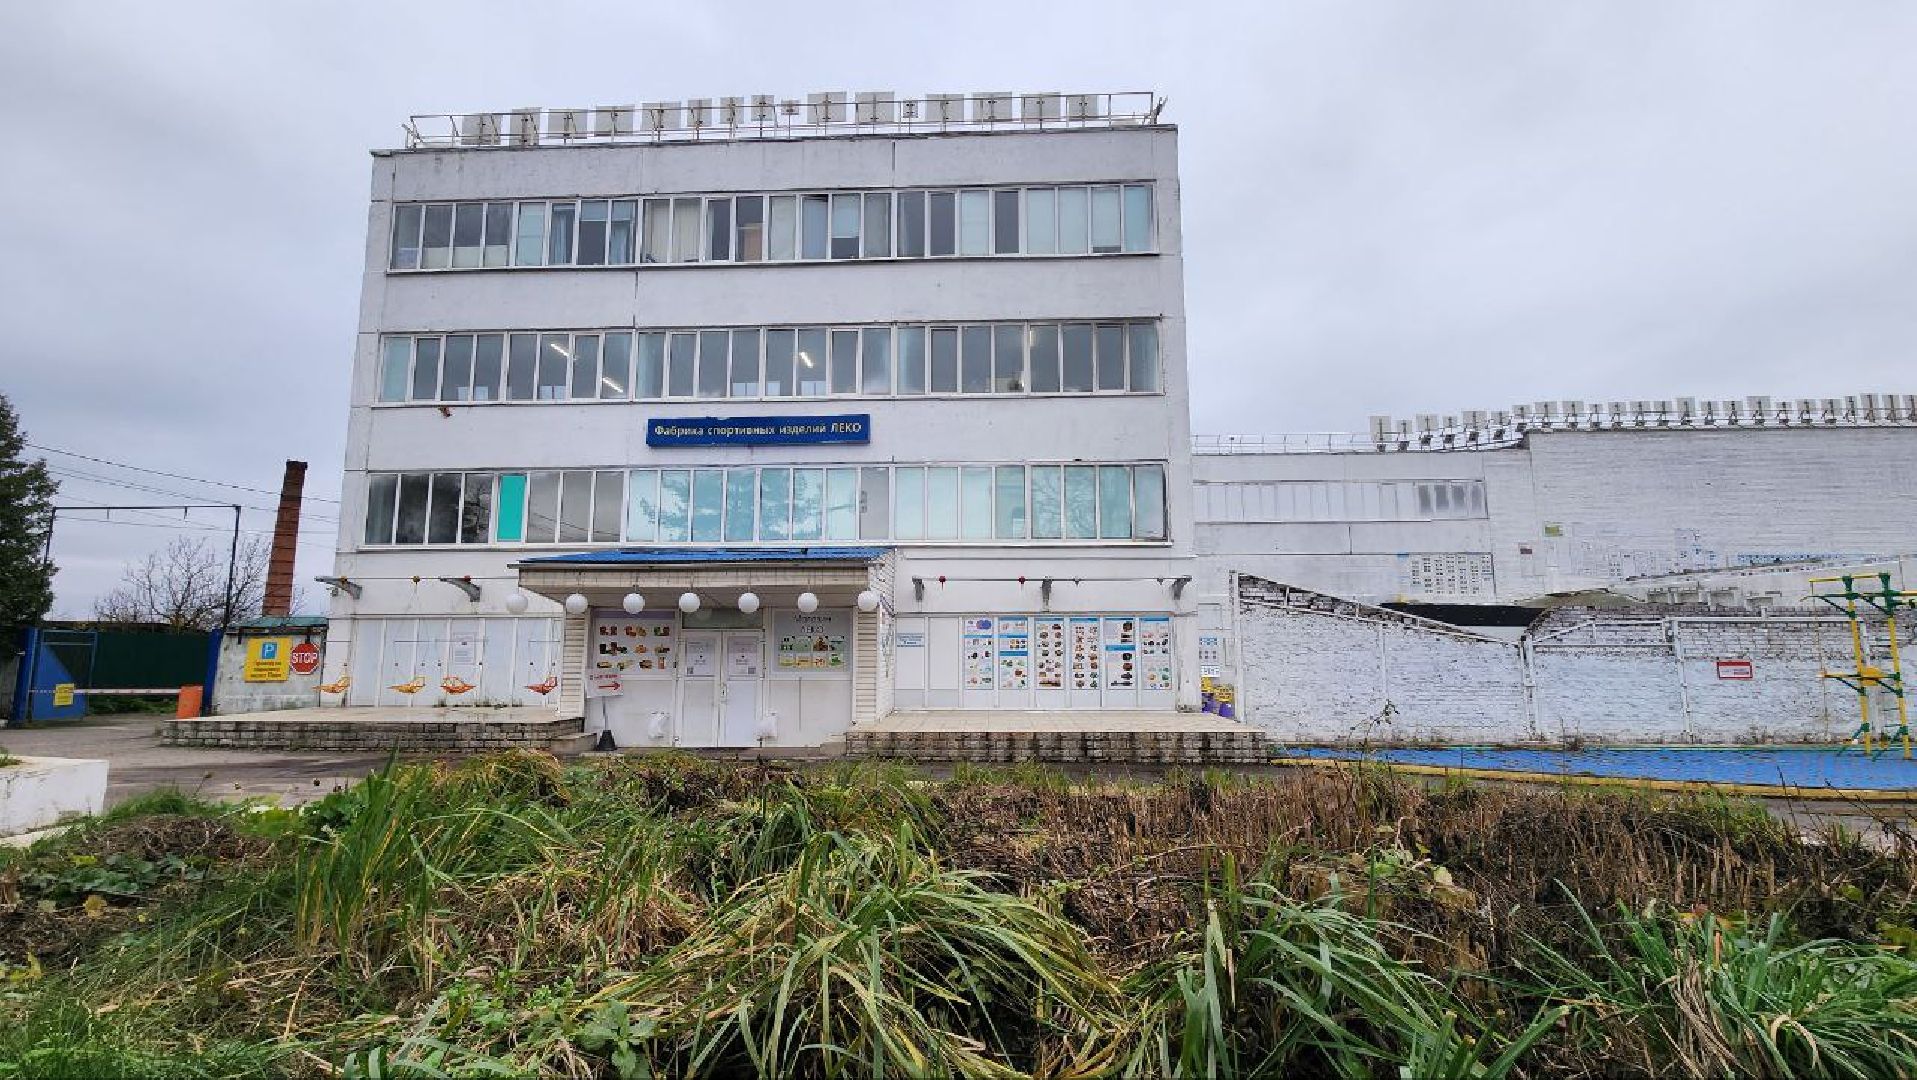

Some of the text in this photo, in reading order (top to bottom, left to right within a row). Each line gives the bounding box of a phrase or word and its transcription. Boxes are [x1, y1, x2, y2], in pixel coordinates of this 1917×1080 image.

[654, 422, 862, 437] Фабрика спортивных изделий ЛЕКО
[292, 652, 318, 664] STOP
